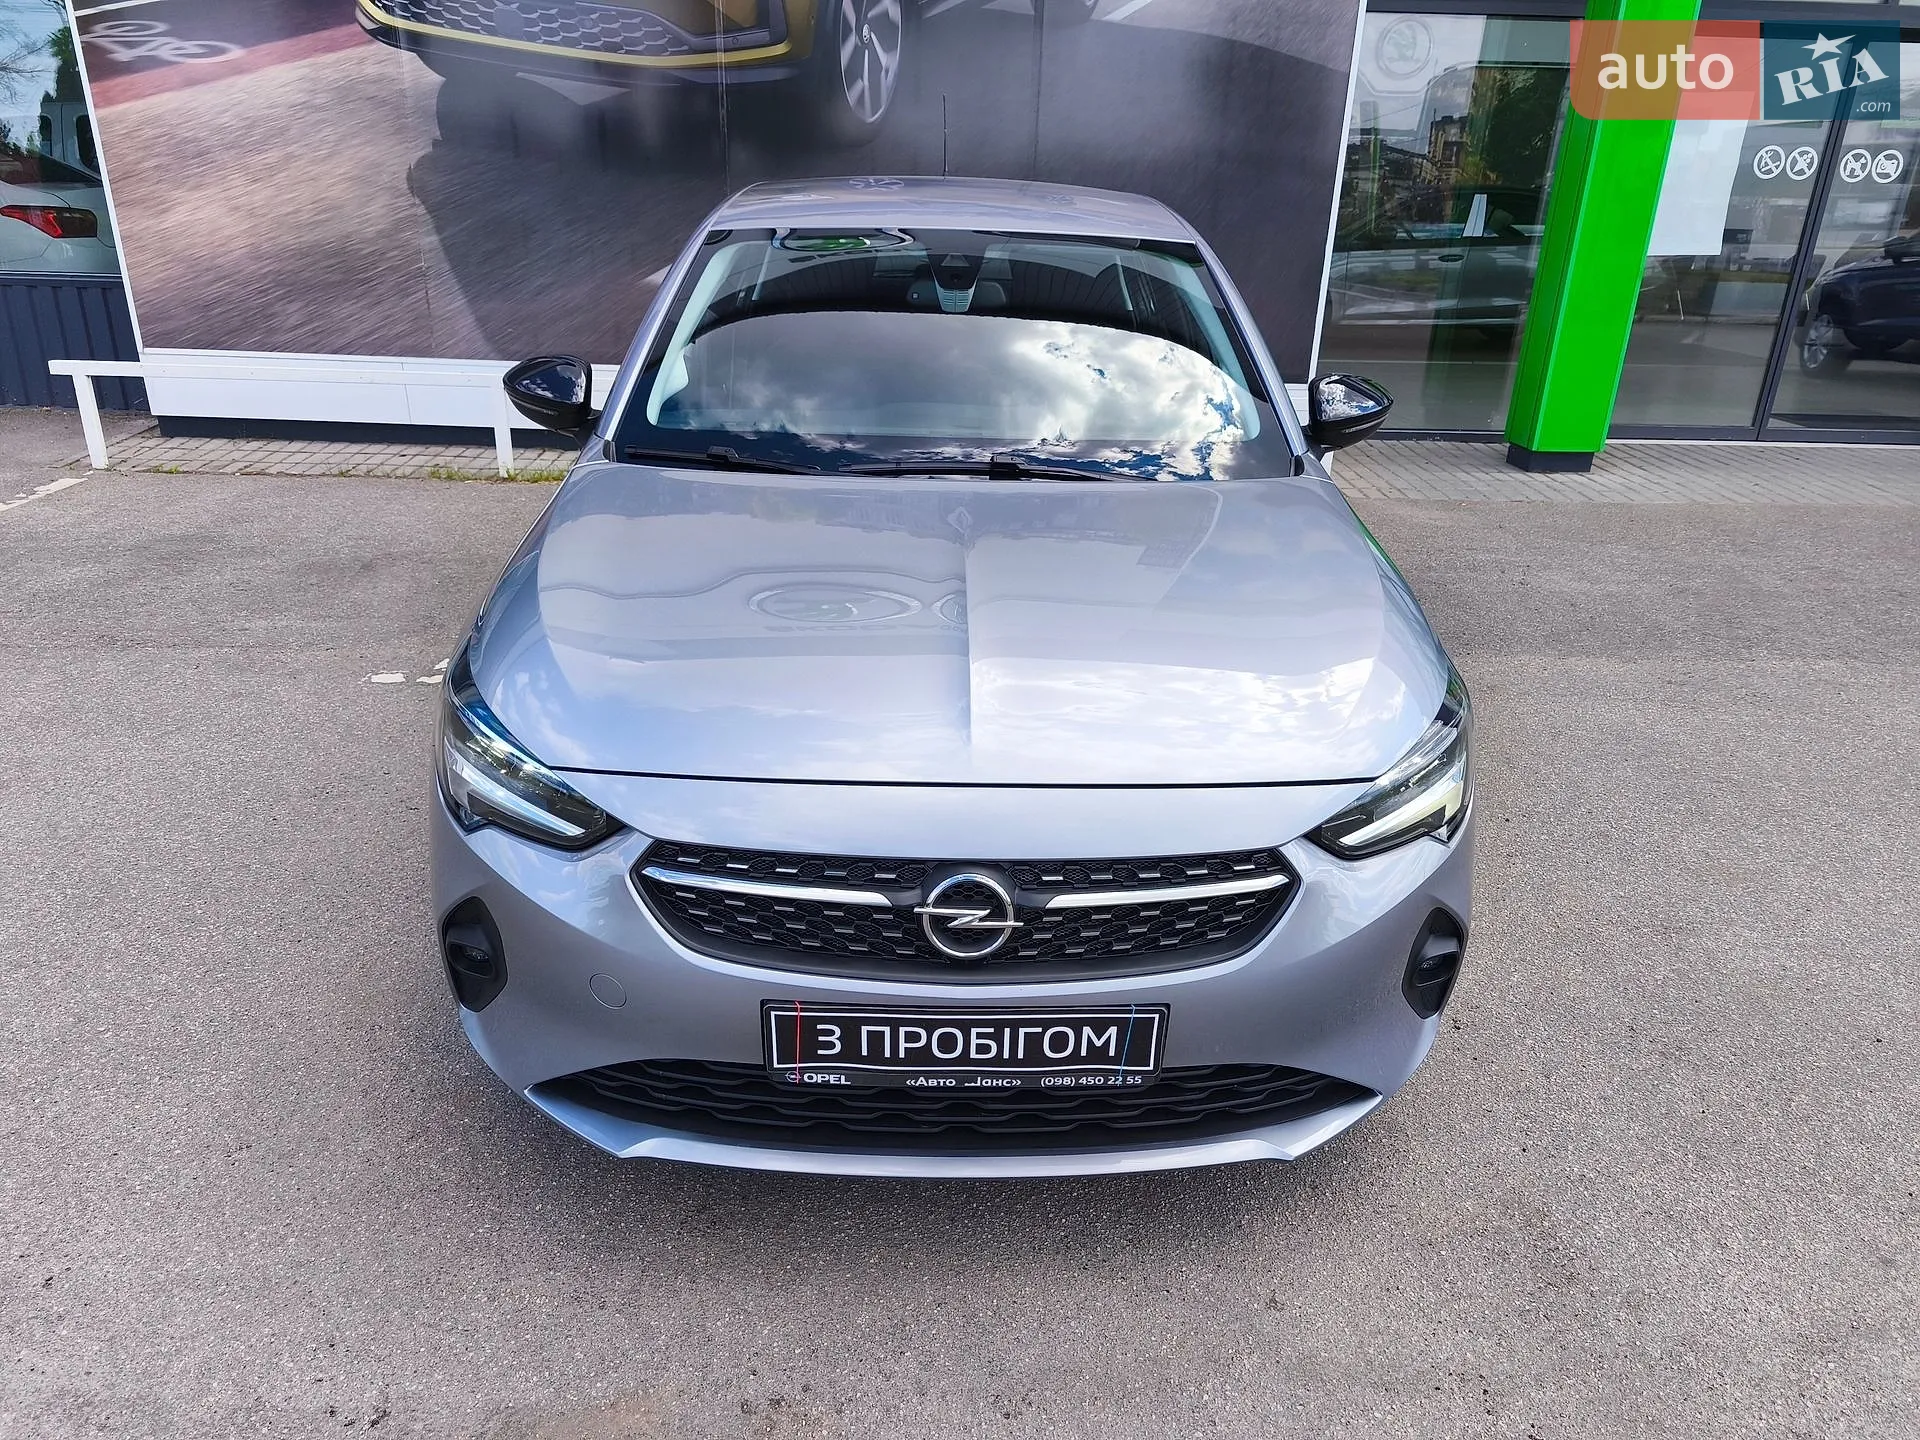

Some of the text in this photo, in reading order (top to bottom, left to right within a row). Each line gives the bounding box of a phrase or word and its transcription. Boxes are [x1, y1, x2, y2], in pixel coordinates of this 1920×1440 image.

[860, 1025, 1118, 1060] ПРОБІГОМ
[803, 1072, 852, 1085] OPEL
[1040, 1075, 1143, 1088] (098) 450 22 55
